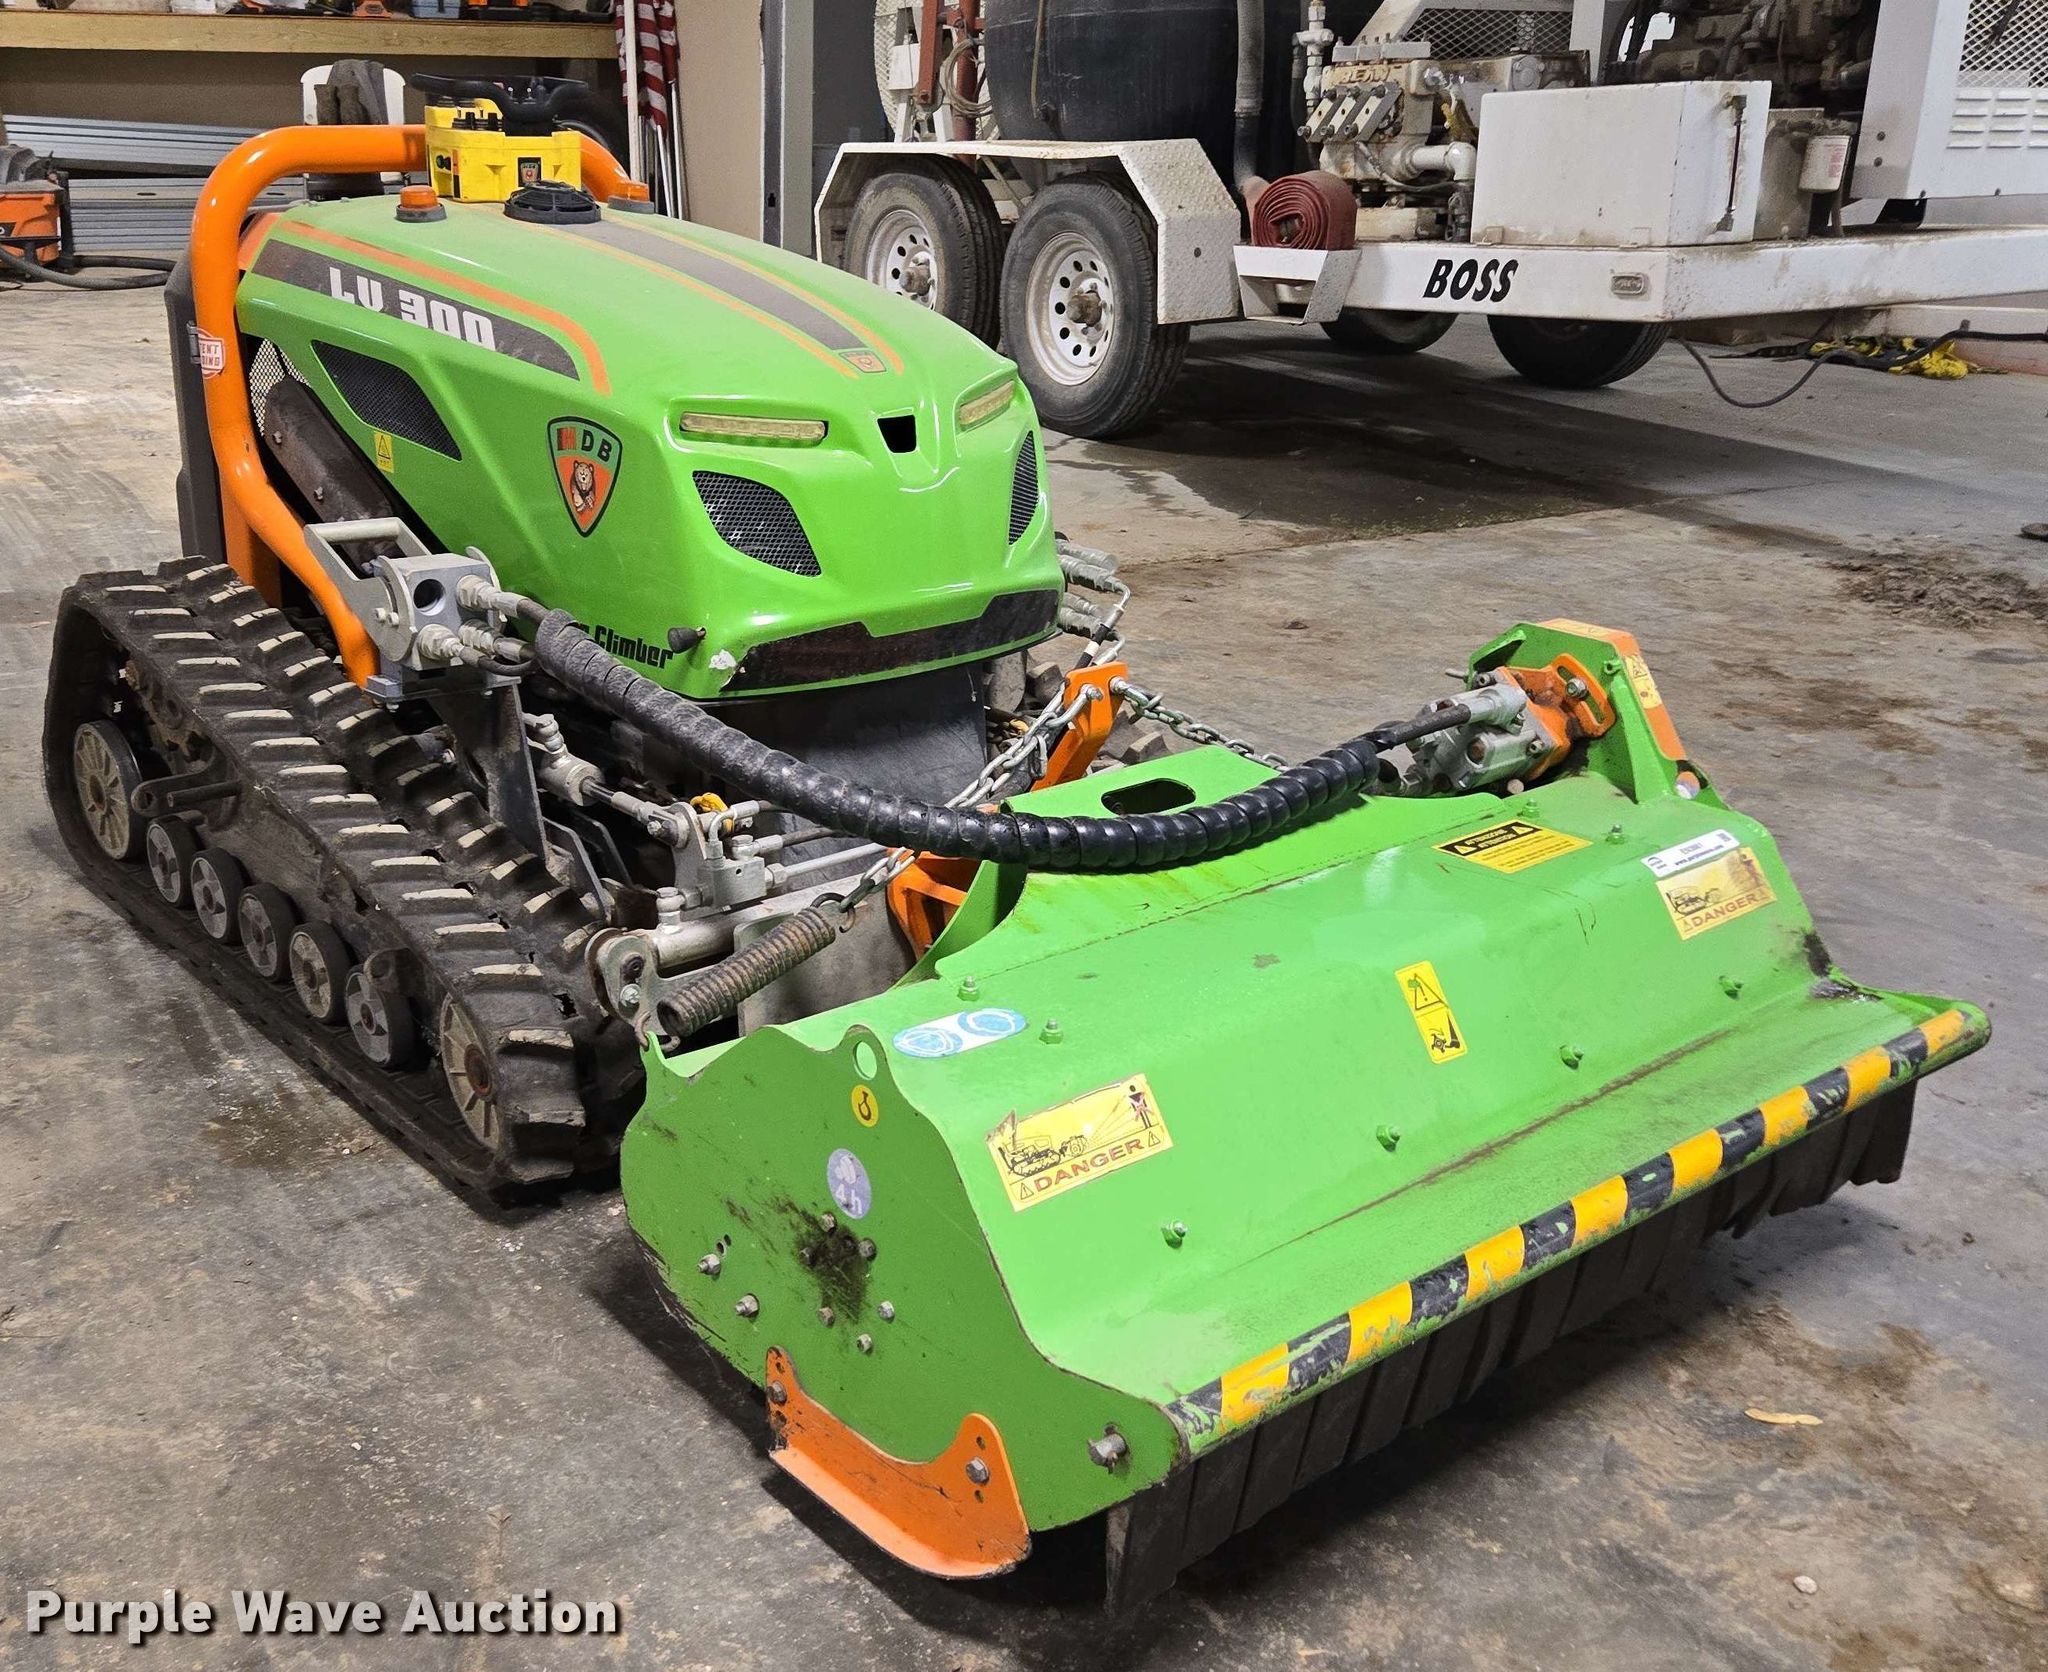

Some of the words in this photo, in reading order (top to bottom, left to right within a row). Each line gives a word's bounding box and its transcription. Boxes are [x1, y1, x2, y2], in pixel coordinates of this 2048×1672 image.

[1423, 259, 1519, 302] BOSS
[398, 289, 496, 351] 300
[594, 625, 674, 669] Climber
[1691, 893, 1760, 928] DANGER
[1034, 1138, 1144, 1192] DANGER
